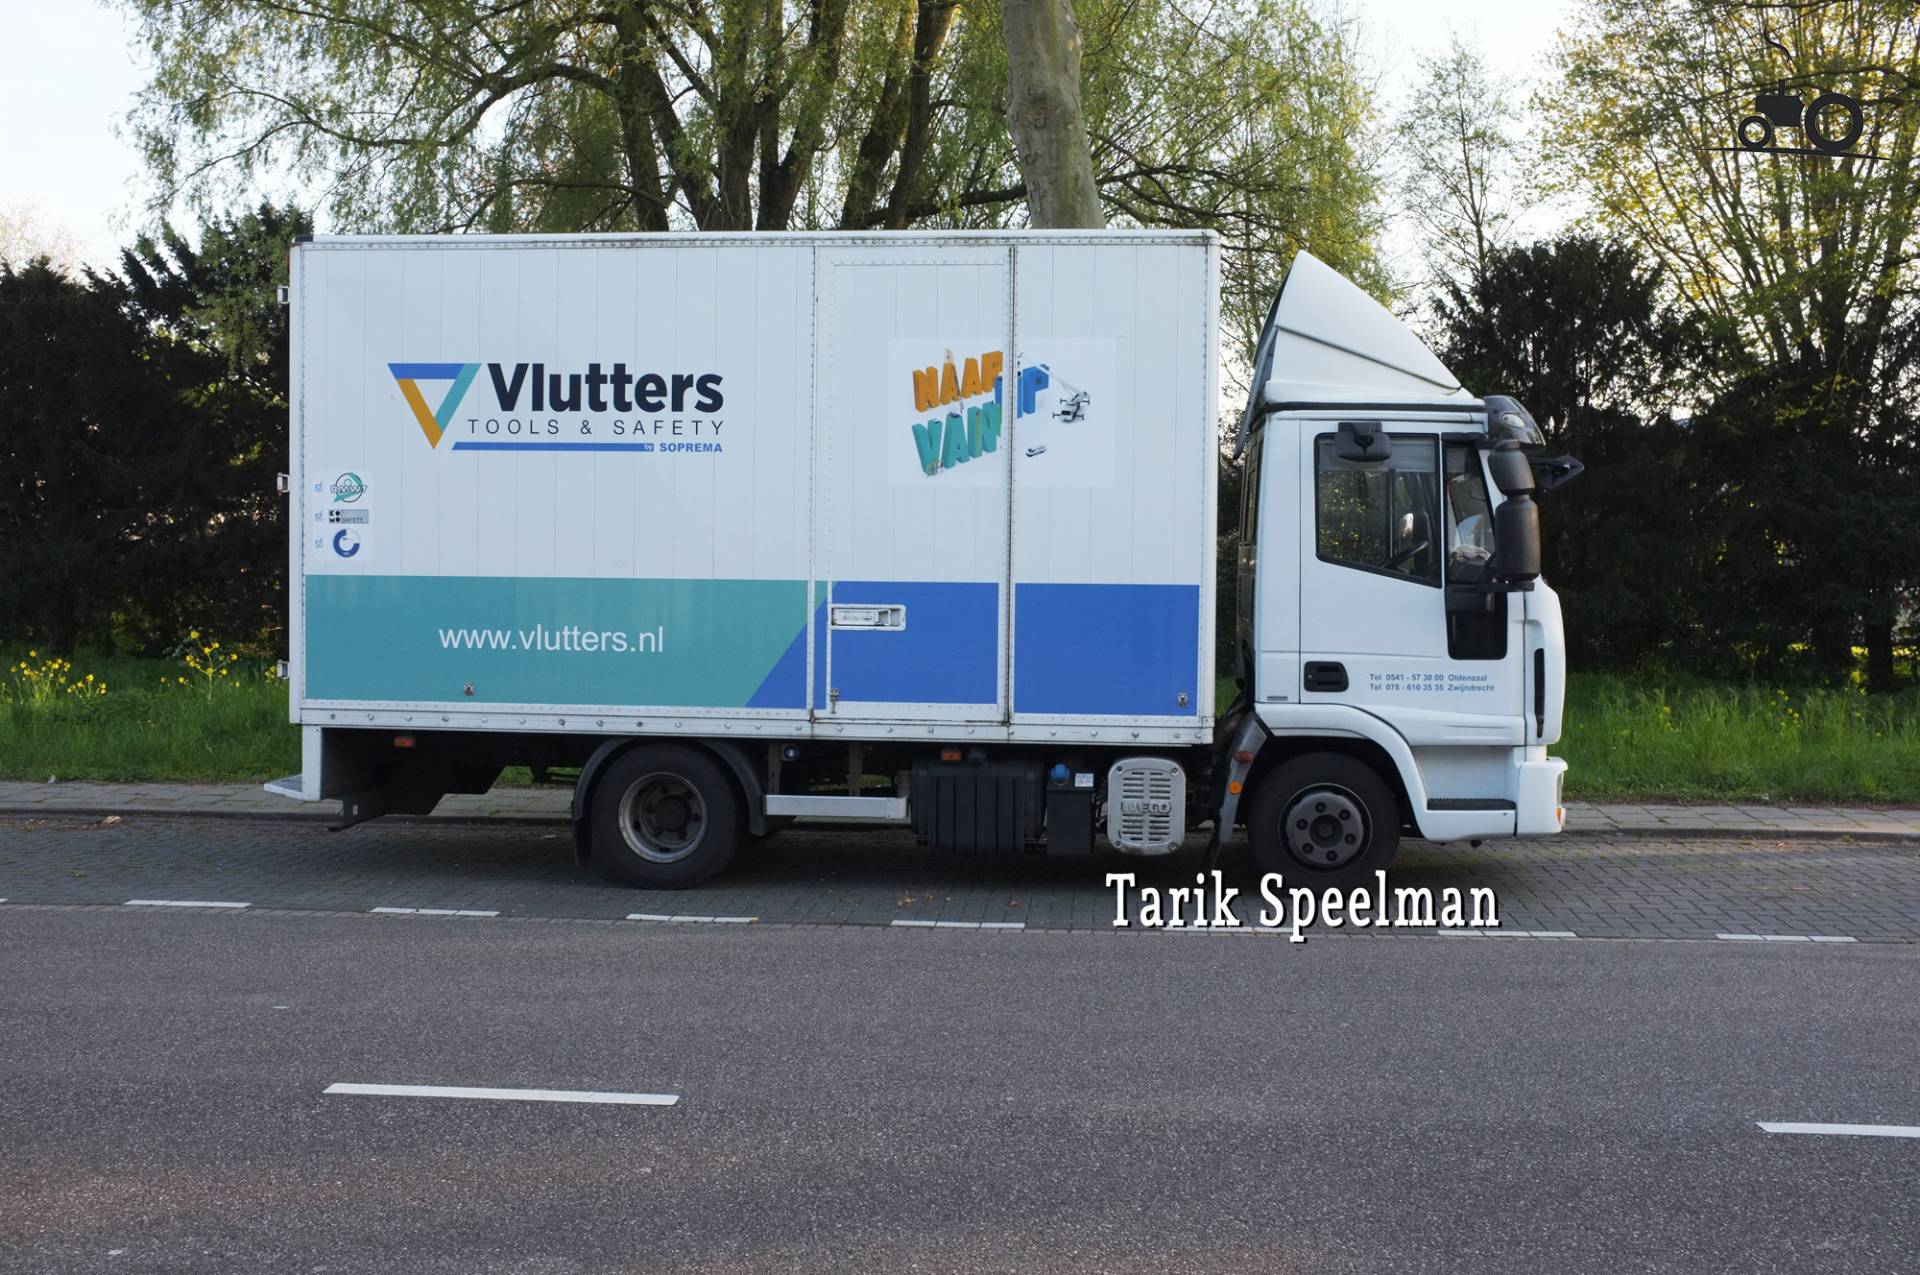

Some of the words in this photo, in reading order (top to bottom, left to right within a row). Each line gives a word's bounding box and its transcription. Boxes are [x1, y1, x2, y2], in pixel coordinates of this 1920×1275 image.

[487, 363, 724, 412] Vlutters
[467, 419, 560, 435] TOOLS
[580, 420, 593, 435] &
[613, 420, 724, 435] SAFETY
[659, 443, 723, 452] SOPREMA
[438, 624, 664, 652] www.vlutters.nl
[1369, 673, 1382, 681] Tel
[1434, 674, 1444, 682] 00
[1448, 673, 1487, 682] Oldenzaal
[1369, 683, 1382, 691] Tel
[1447, 684, 1495, 693] Zwijndrecht
